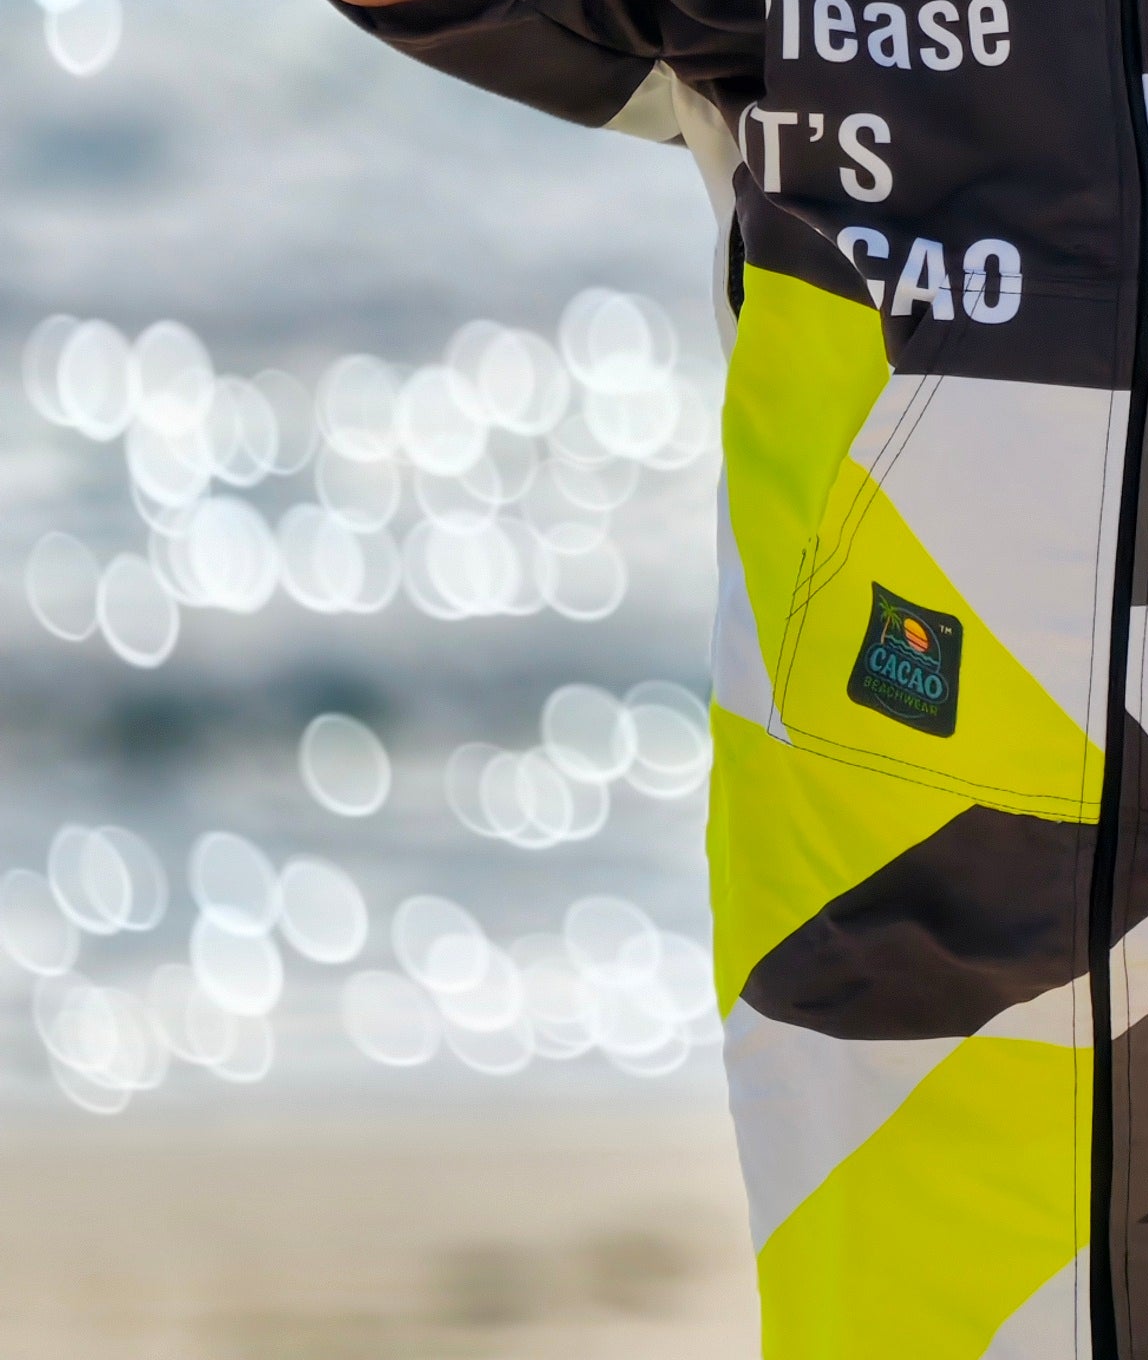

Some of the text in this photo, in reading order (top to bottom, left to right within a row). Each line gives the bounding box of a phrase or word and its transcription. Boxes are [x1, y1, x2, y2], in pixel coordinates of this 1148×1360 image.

[836, 225, 1023, 325] CAO
[863, 675, 939, 717] BEACHWEAR
[869, 647, 944, 700] CACAO
